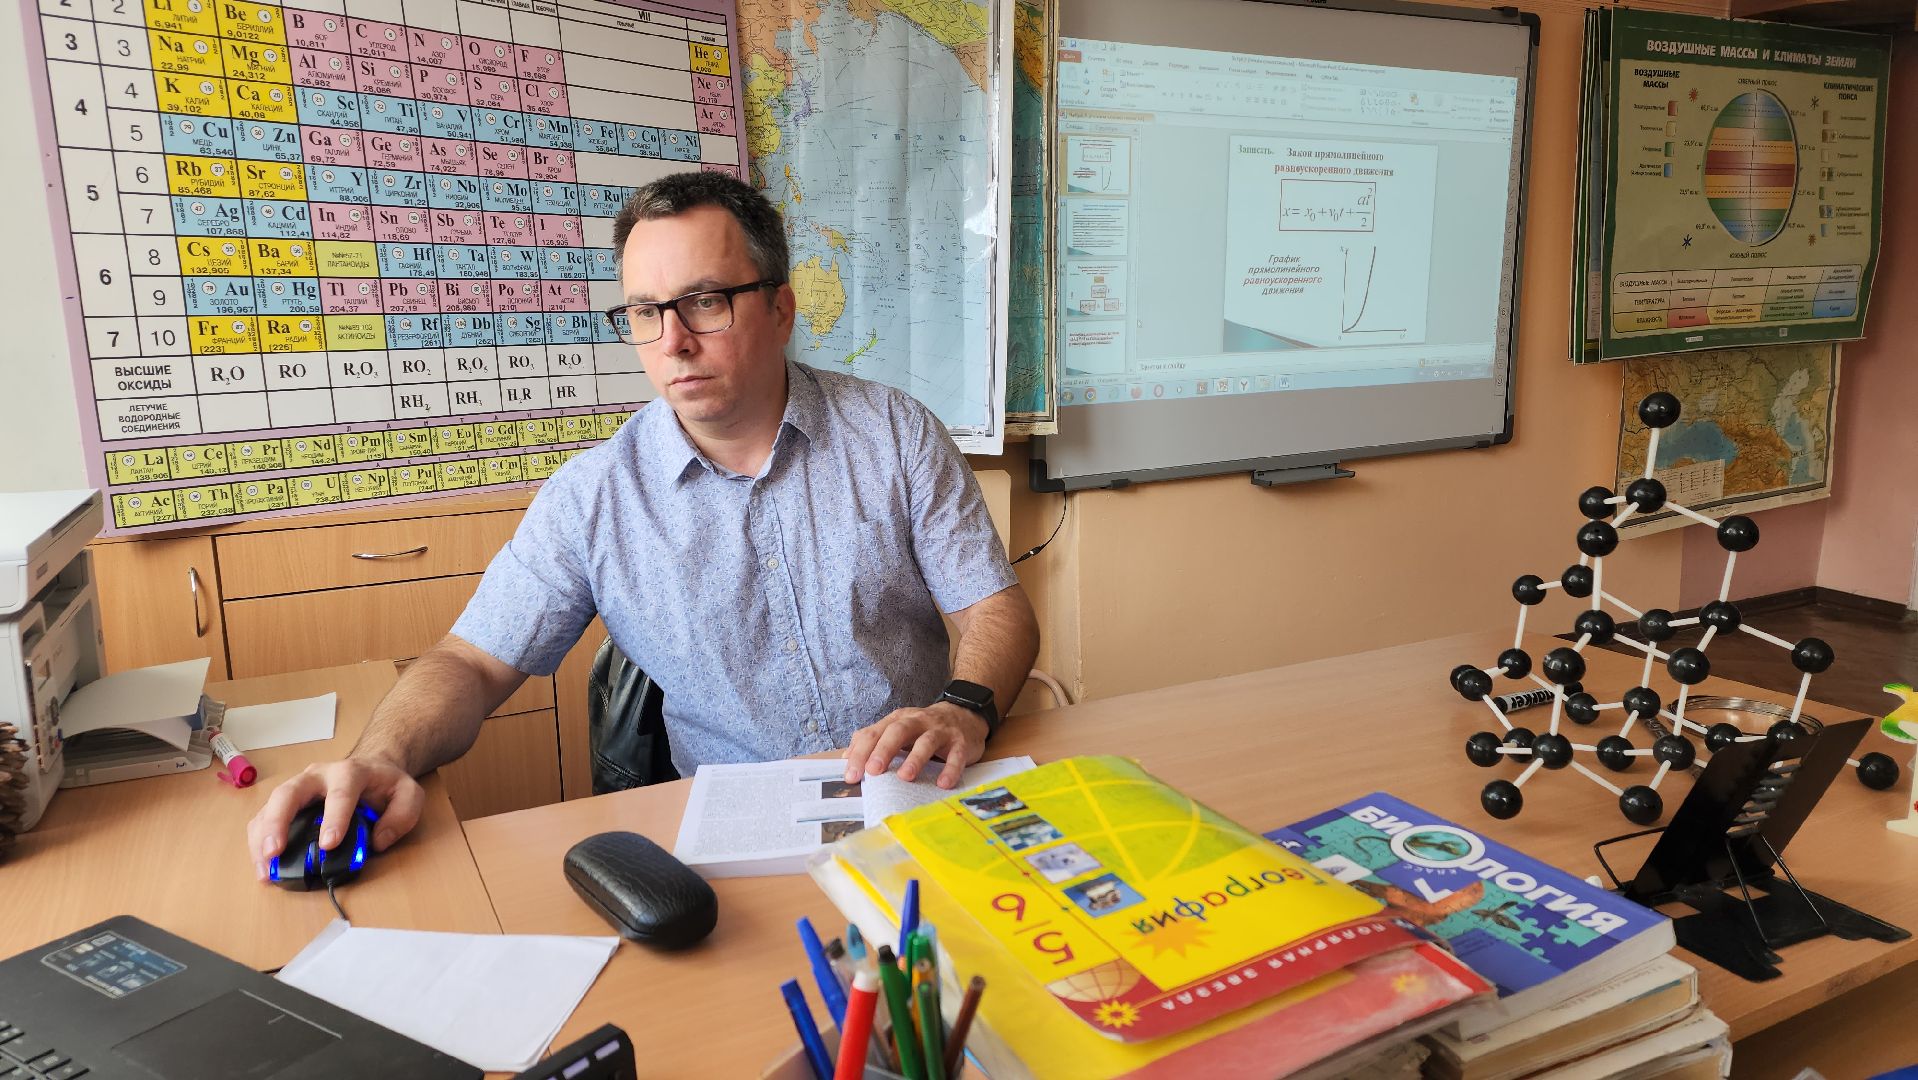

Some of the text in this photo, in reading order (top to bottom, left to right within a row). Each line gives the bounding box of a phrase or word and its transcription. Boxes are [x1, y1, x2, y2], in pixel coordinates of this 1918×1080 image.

[112, 0, 126, 14] 2
[224, 4, 247, 20] Be
[292, 14, 305, 28] B
[226, 30, 260, 40] 9,0122
[356, 24, 368, 38] C
[64, 33, 78, 50] 3
[158, 34, 184, 52] Na
[296, 39, 325, 48] 10,811
[414, 32, 426, 46] N
[117, 40, 131, 56] 3
[231, 44, 260, 66] Mg
[358, 48, 386, 57] 12,011
[694, 46, 709, 60] He
[1647, 40, 1856, 68] ВОЗДУШНЫЕ МАССЫ И КЛИМАТЫ ЗЕМЛИ
[299, 54, 318, 69] Al
[520, 50, 530, 62] F
[232, 70, 266, 80] 24,312
[360, 61, 376, 76] Si
[1634, 68, 1680, 79] ВОЗДУШНЫЕ
[420, 70, 428, 82] P
[124, 82, 139, 98] 4
[164, 77, 182, 94] K
[474, 77, 482, 90] S
[1643, 80, 1669, 88] МАССЫ
[1824, 81, 1874, 92] КЛИМАТИЧЕСКИЕ
[236, 84, 260, 101] Ca
[526, 84, 540, 98] Cl
[74, 98, 88, 116] 4
[167, 104, 202, 114] 39,102
[336, 95, 356, 110] Sc
[239, 110, 266, 119] 40,08
[398, 102, 415, 118] Ti
[457, 110, 468, 122] V
[504, 114, 520, 129] Cr
[548, 120, 569, 134] Mn
[130, 124, 144, 142] 5
[202, 121, 229, 138] Cu
[272, 128, 296, 144] Zn
[600, 126, 614, 138] Fe
[642, 130, 656, 142] Co
[308, 130, 332, 146] Ga
[371, 136, 392, 152] Ge
[685, 135, 698, 148] Ni
[430, 142, 447, 156] As
[482, 147, 498, 160] Se
[1287, 148, 1312, 158] Закон
[275, 153, 300, 161] 65,37
[534, 152, 549, 164] Br
[136, 166, 149, 184] 6
[176, 160, 202, 176] Rb
[246, 165, 266, 180] Sr
[350, 171, 363, 186] Y
[404, 175, 422, 190] Zr
[86, 184, 100, 201] 5
[456, 180, 477, 194] Nb
[506, 183, 528, 197] Mo
[140, 208, 154, 224] 7
[215, 203, 240, 222] Ag
[282, 205, 306, 222] Cd
[318, 208, 336, 222] In
[380, 211, 398, 225] Sn
[437, 213, 455, 227] Sb
[490, 216, 506, 230] Te
[206, 227, 244, 236] 107,868
[280, 230, 310, 238] 112,41
[187, 242, 210, 256] Cs
[258, 244, 280, 258] Ba
[413, 248, 432, 261] Hf
[468, 248, 484, 262] Ta
[520, 250, 534, 262] W
[148, 249, 162, 266] 8
[1268, 254, 1301, 266] График
[100, 268, 112, 286] 6
[1248, 264, 1320, 276] прямолинейного
[225, 281, 249, 296] Au
[1243, 276, 1322, 287] равноускоренного
[292, 281, 316, 300] Hg
[389, 282, 408, 296] Pb
[444, 283, 460, 296] Bi
[498, 284, 514, 296] Po
[1262, 286, 1304, 296] движения
[153, 290, 166, 306] 9
[210, 298, 238, 306] ЗОЛОТО
[216, 306, 254, 314] 196,967
[290, 305, 320, 313] 200,59
[198, 320, 218, 336] Fr
[266, 320, 290, 334] Ra
[422, 318, 439, 331] Rf
[472, 317, 491, 330] Db
[525, 318, 541, 332] Sg
[106, 331, 120, 348] 7
[150, 330, 176, 347] 10
[200, 346, 225, 354] [223]
[269, 344, 293, 352] [226]
[114, 364, 172, 378] ВЫСШИЕ
[278, 364, 306, 378] RO
[118, 378, 172, 390] ОКСИДЫ
[556, 386, 578, 398] HR
[129, 404, 168, 413] ЛЕТУЧИЕ
[118, 412, 181, 424] ВОДОРОДНЫЕ
[121, 422, 180, 434] СОЕДИНЕНИЯ
[143, 453, 164, 466] La
[204, 448, 223, 460] Ce
[326, 477, 336, 488] U
[151, 496, 171, 508] Ac
[208, 488, 230, 502] Th
[1350, 806, 1628, 933] БИОЛОГИЯ
[1160, 967, 1260, 1012] ЗВЕЗДА
